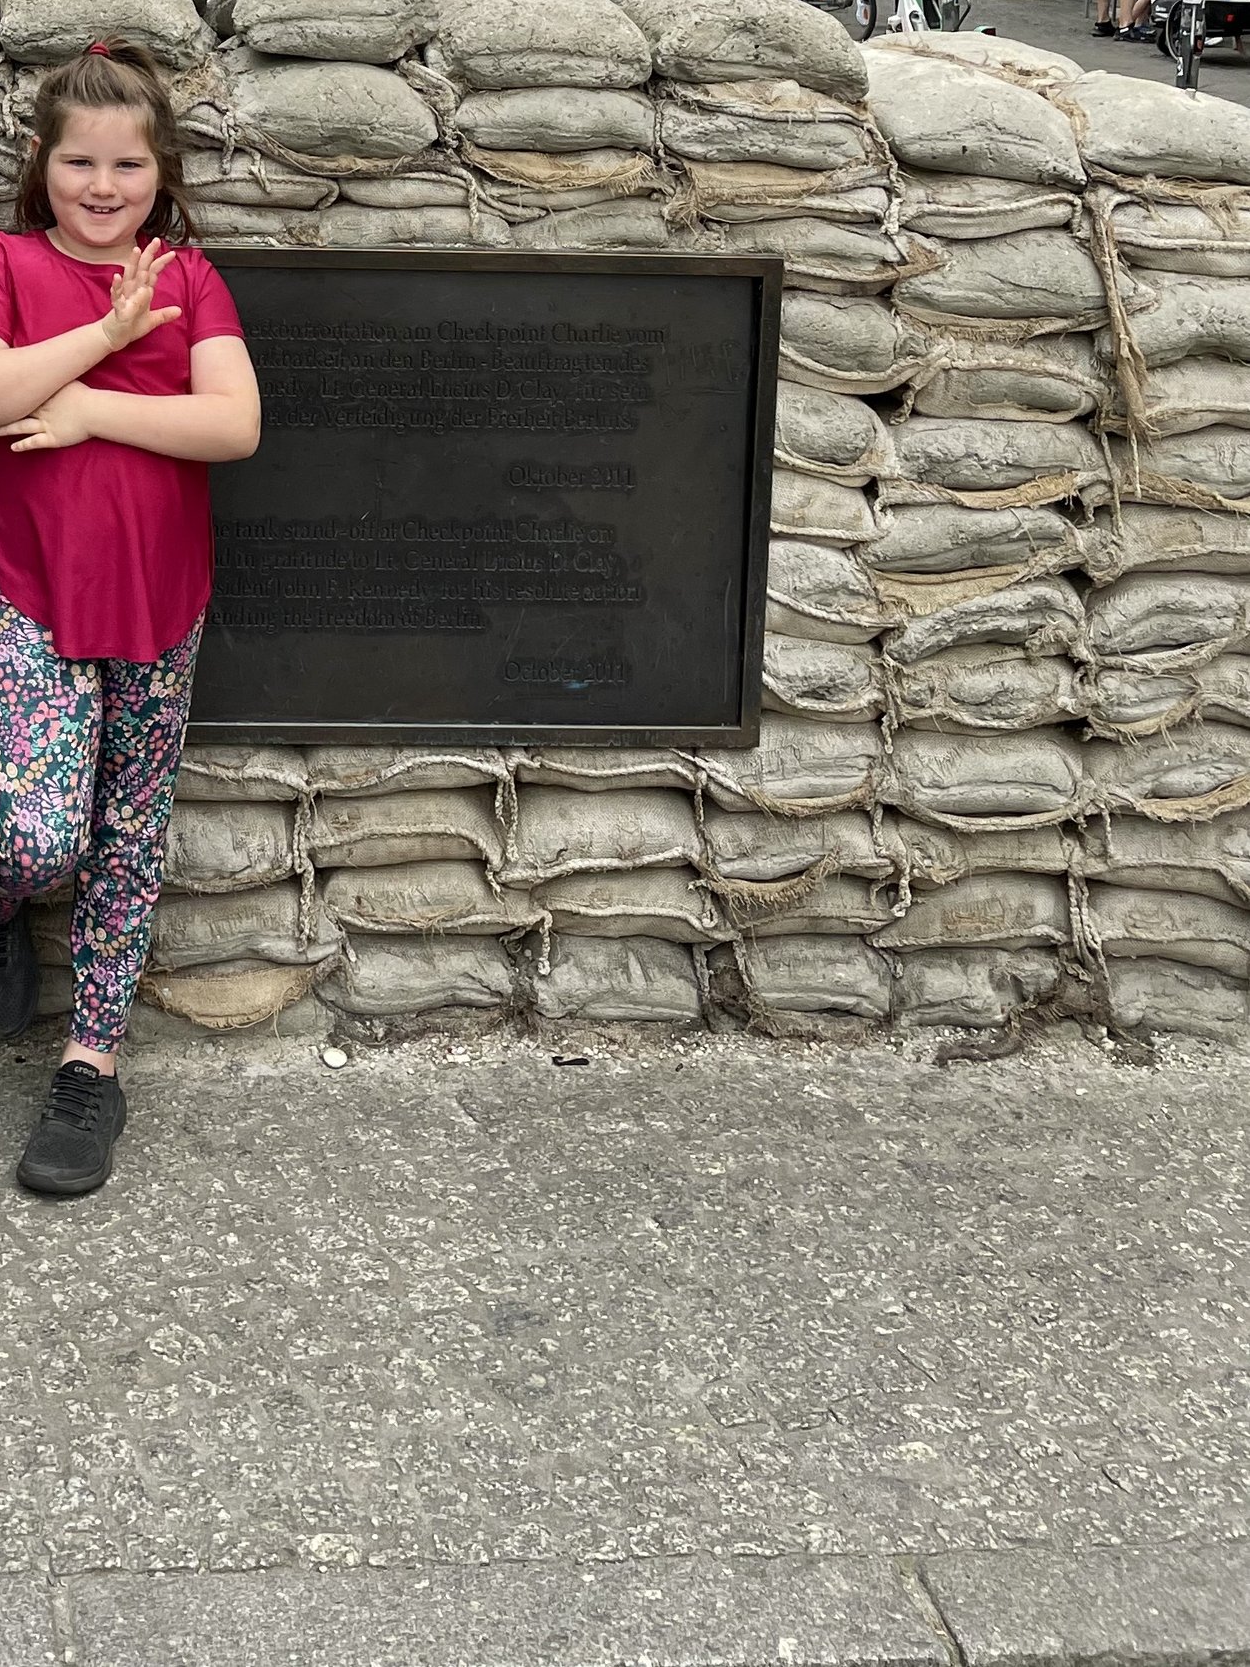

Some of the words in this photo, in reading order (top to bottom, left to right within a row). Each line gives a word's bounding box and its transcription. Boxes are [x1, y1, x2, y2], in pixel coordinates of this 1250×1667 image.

[437, 321, 546, 348] Checkpoint
[551, 321, 619, 343] Charlie
[349, 378, 424, 400] General
[508, 466, 584, 488] Oktober
[591, 466, 637, 489] 2011
[235, 518, 279, 541] tank
[402, 520, 511, 550] Checkpoint
[515, 520, 584, 543] Charlie
[261, 549, 347, 576] gratitude
[403, 549, 479, 573] General
[482, 551, 545, 574] Lucius
[317, 607, 396, 629] freedom
[503, 660, 581, 684] October
[584, 660, 627, 685] 2011
